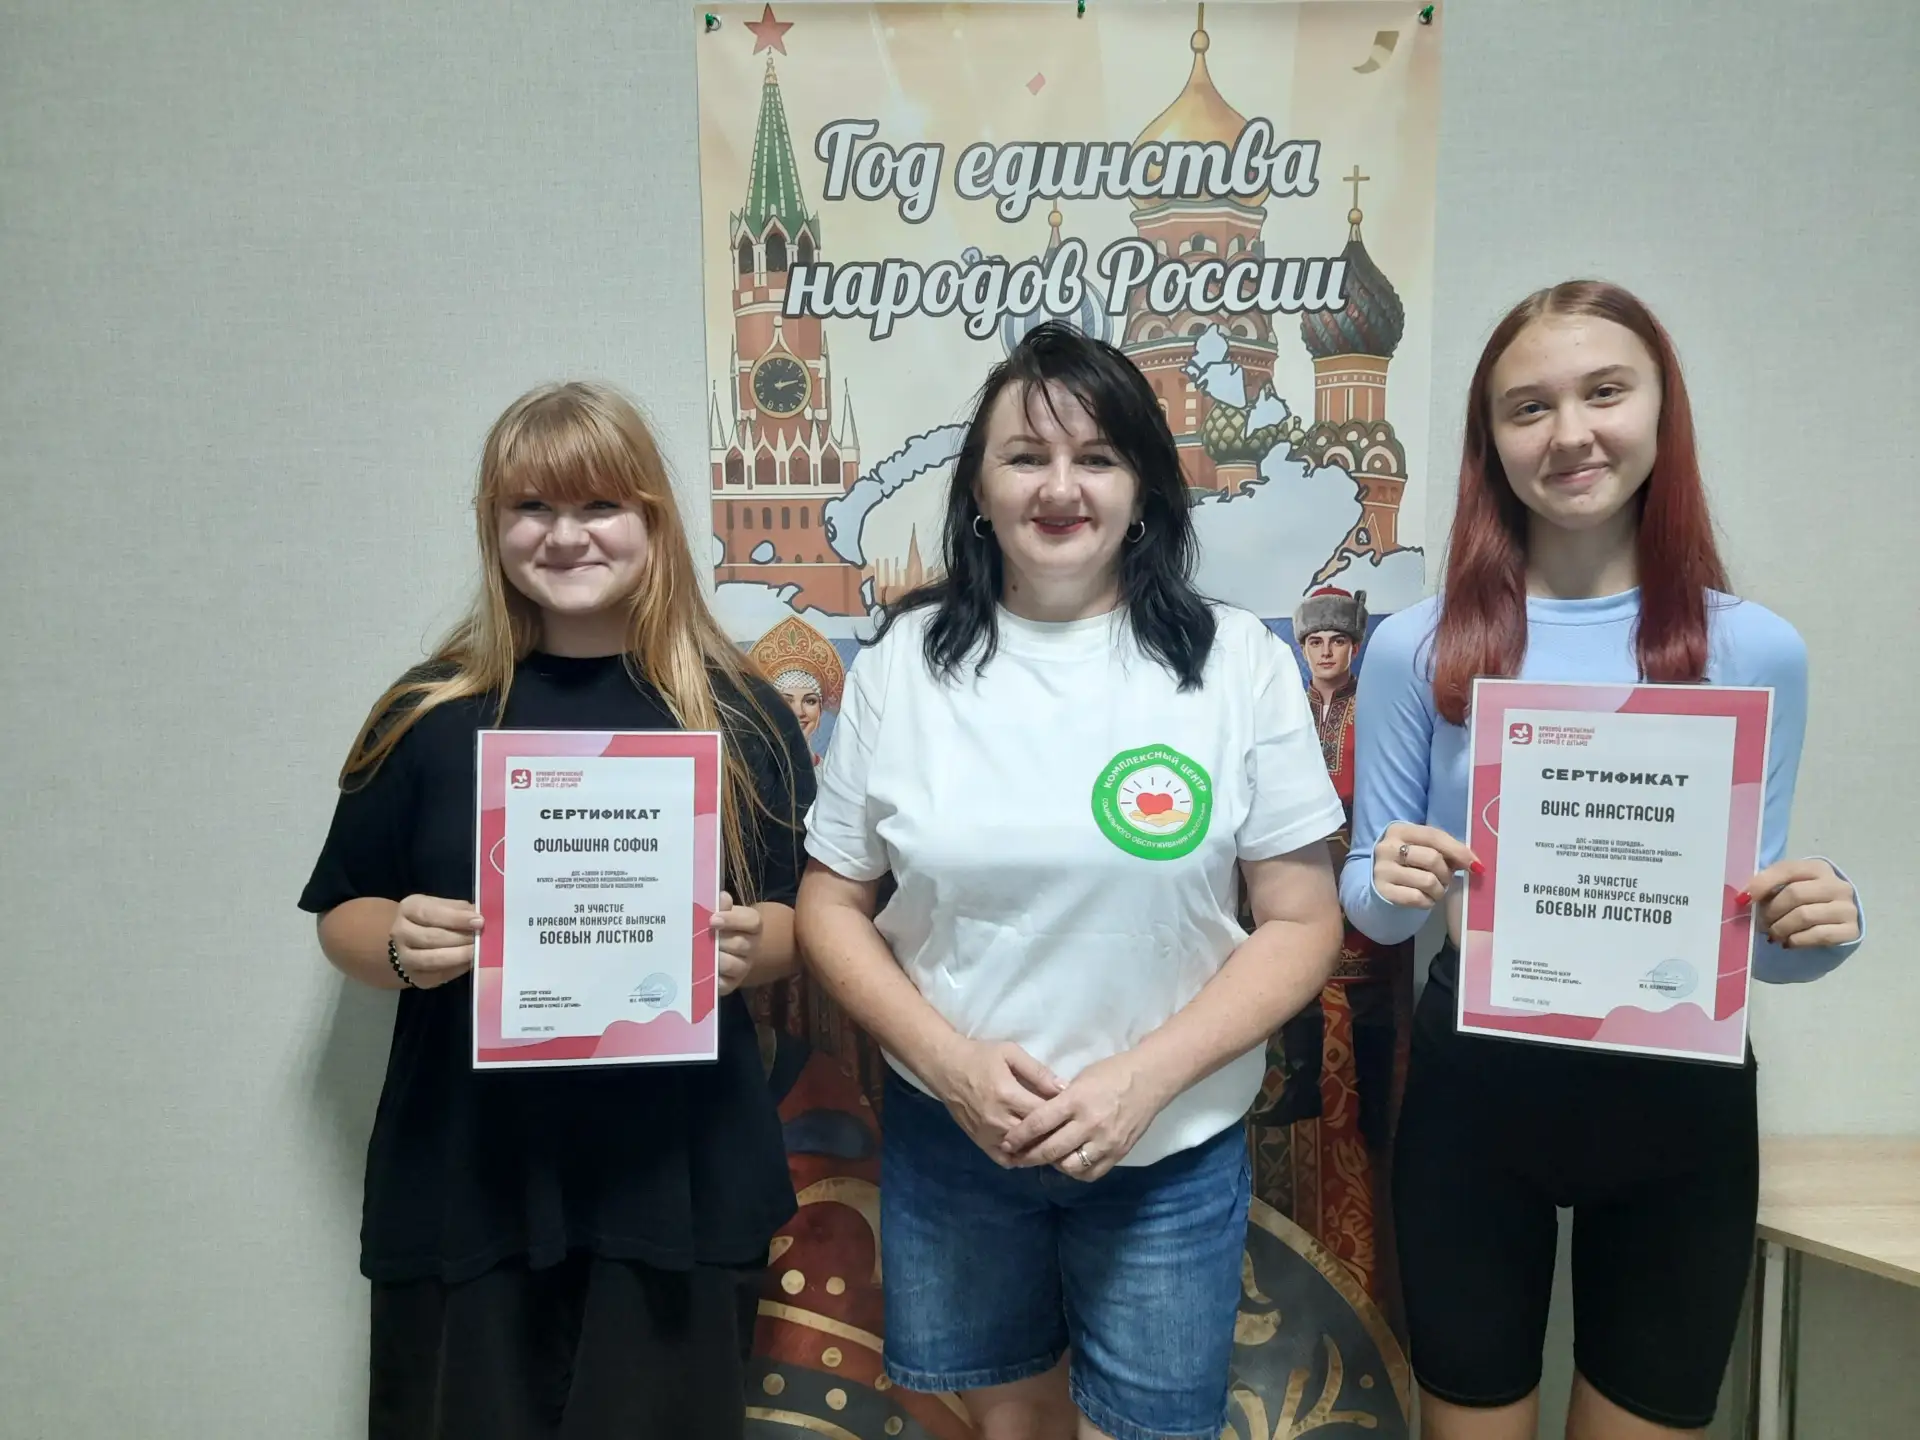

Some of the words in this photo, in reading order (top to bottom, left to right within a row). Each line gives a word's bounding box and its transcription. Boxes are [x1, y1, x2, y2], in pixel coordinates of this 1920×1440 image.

[815, 119, 943, 224] Год
[955, 118, 1319, 223] единства
[785, 238, 1087, 340] народов
[1099, 240, 1350, 316] России
[1104, 751, 1180, 788] КОМПЛЕКСНЫЙ
[1180, 764, 1207, 792] ЦЕНТР
[1541, 768, 1689, 787] СЕРТИФИКАТ
[540, 809, 661, 820] СЕРТИФИКАТ
[1541, 800, 1580, 817] ВИНС
[1585, 803, 1675, 823] АНАСТАСИЯ
[533, 838, 609, 853] ФИЛЬШИНА
[614, 838, 658, 852] СОФИЯ
[1131, 836, 1189, 849] ОБСЛУЖИВАНИЯ
[1577, 874, 1590, 885] ЗА
[1593, 875, 1638, 888] УЧАСТИЕ
[1523, 883, 1530, 894] В
[1533, 884, 1581, 899] КРАЕВОМ
[1584, 889, 1636, 902] КОНКУРСЕ
[1639, 893, 1689, 906] ВЫПУСКА
[574, 904, 585, 913] ЗА
[588, 903, 625, 913] УЧАСТИЕ
[1535, 900, 1597, 919] БОЕВЫХ
[1602, 906, 1673, 925] ЛИСТКОВ
[528, 917, 534, 926] В
[537, 916, 577, 926] КРАЕВОМ
[580, 916, 623, 926] КОНКУРСЕ
[625, 915, 666, 925] ВЫПУСКА
[539, 931, 591, 944] БОЕВЫХ
[596, 930, 654, 944] ЛИСТКОВ
